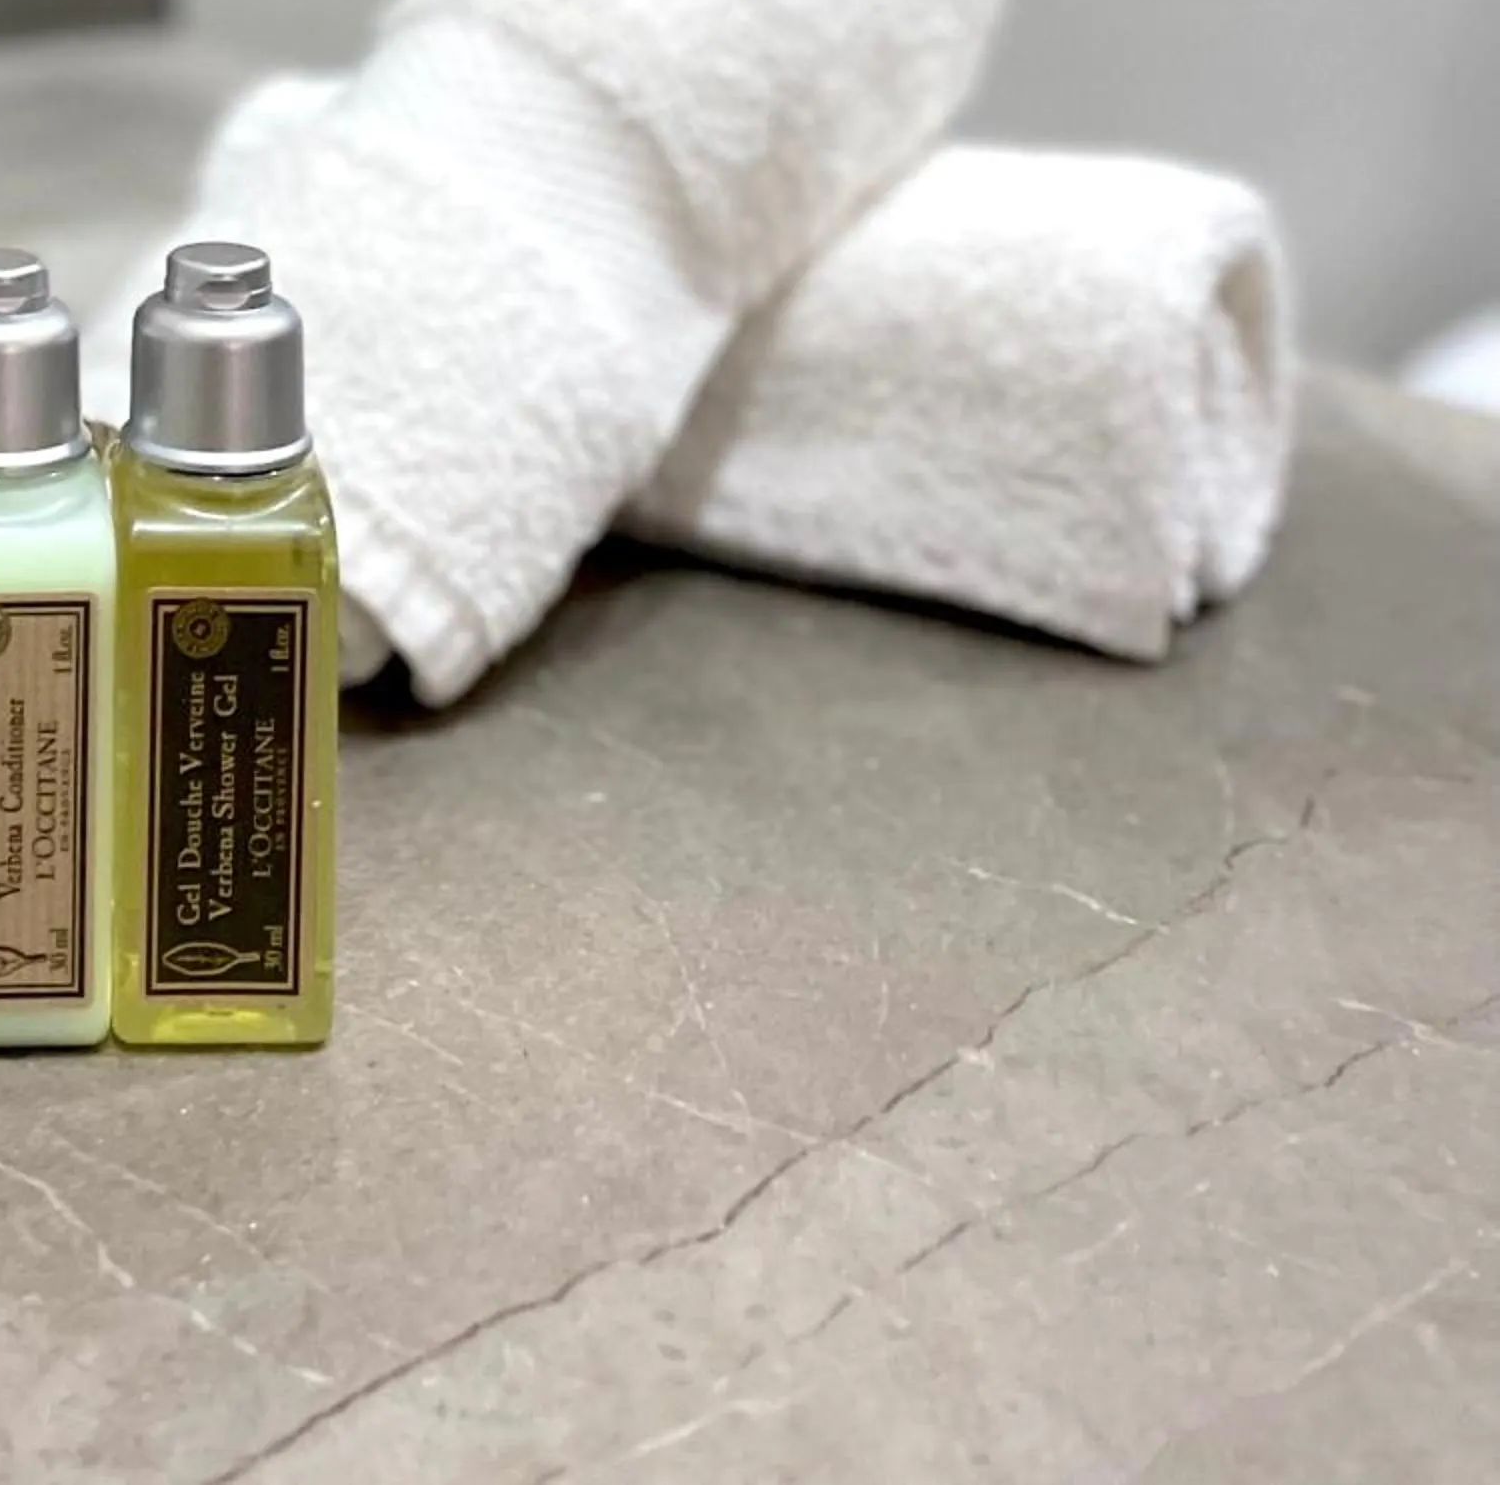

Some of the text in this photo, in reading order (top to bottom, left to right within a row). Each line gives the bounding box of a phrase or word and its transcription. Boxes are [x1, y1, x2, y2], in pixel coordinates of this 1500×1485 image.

[179, 670, 205, 775] Verveine
[31, 718, 58, 881] L'OCCITANE
[177, 779, 203, 869] Douche
[208, 674, 239, 921] Verbena Shower Gel
[248, 717, 275, 878] L'OCCITANE
[177, 883, 201, 926] Gel
[263, 925, 283, 972] 30 ml
